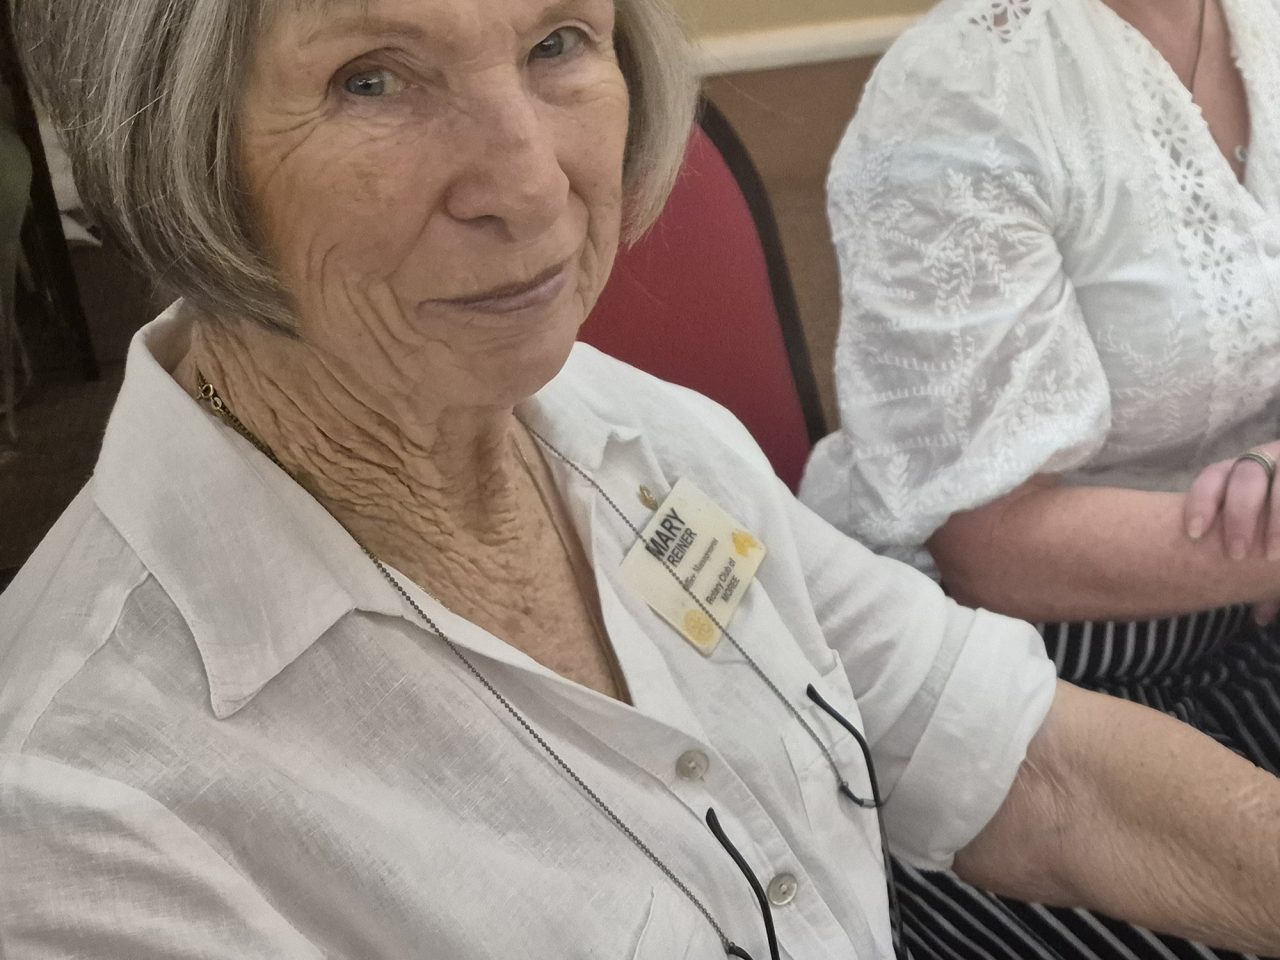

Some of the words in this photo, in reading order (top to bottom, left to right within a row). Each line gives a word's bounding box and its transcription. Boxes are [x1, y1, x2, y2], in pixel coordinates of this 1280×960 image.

[644, 507, 686, 561] MARY
[667, 527, 697, 567] REINER
[718, 565, 731, 582] Club
